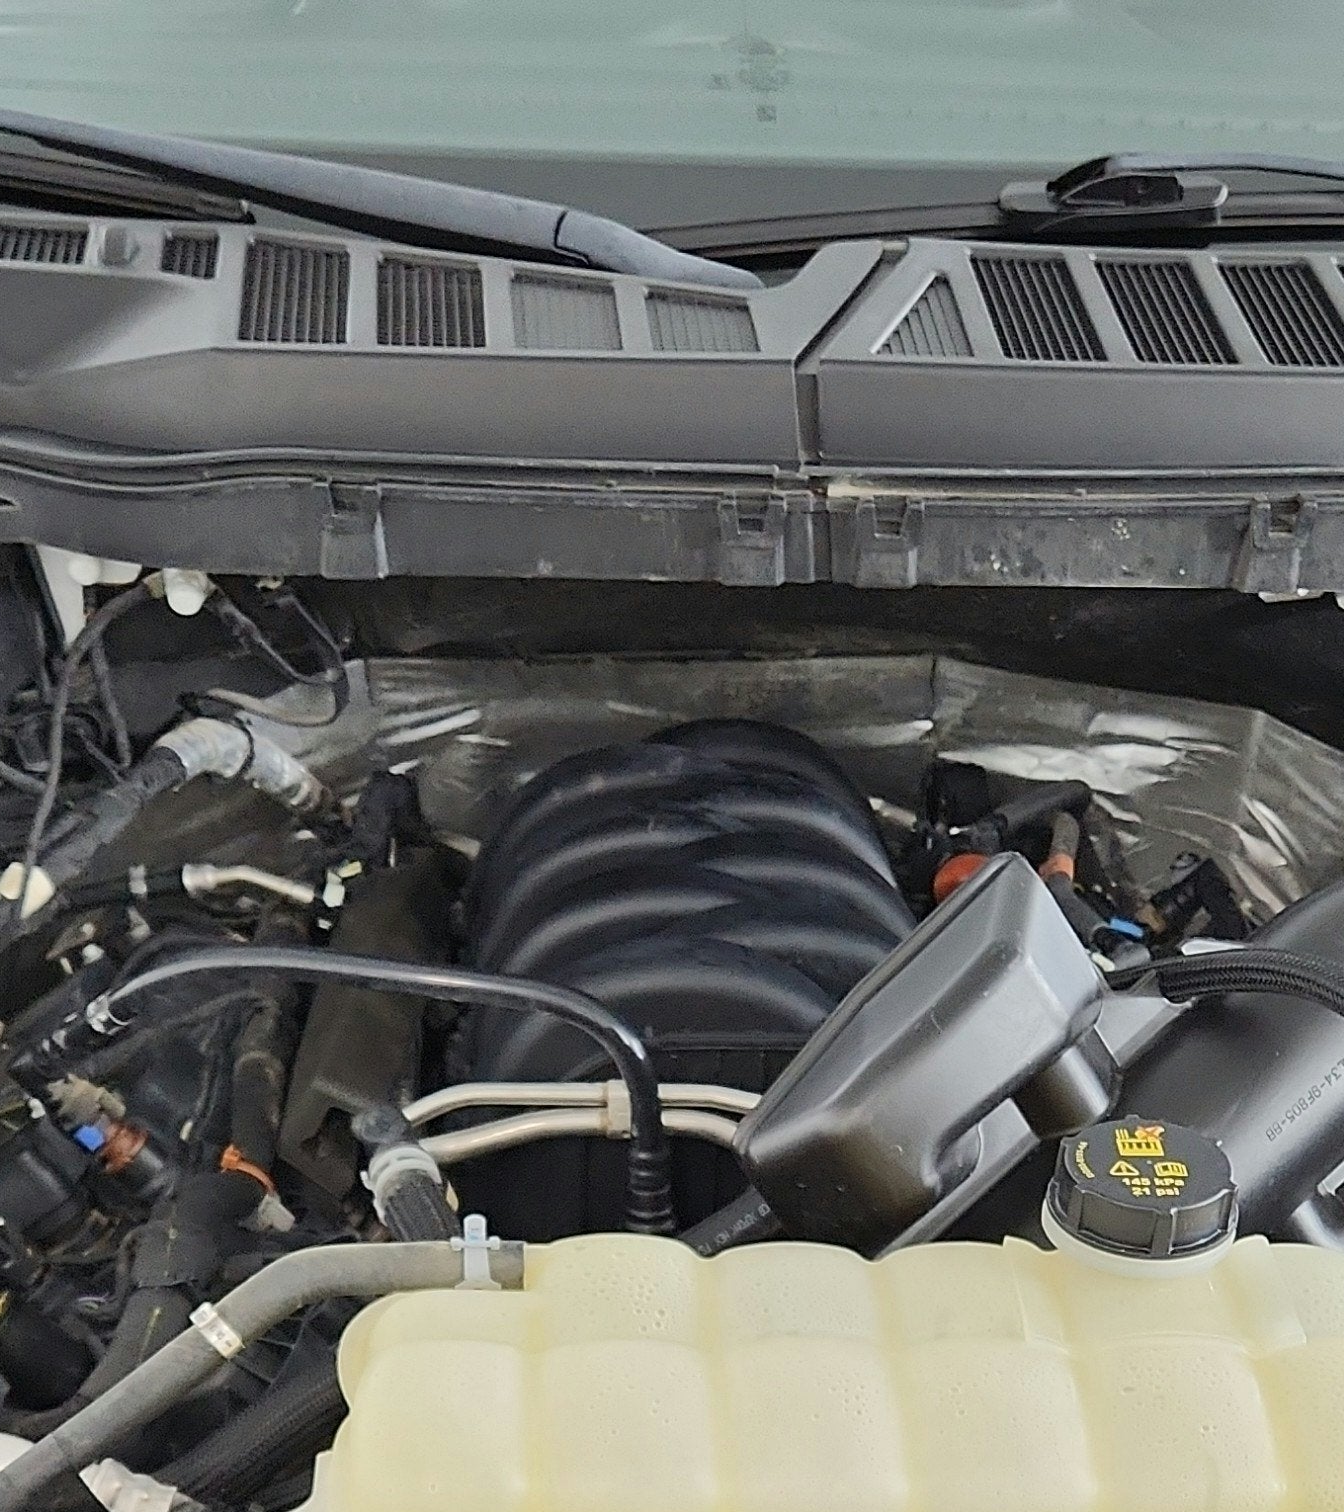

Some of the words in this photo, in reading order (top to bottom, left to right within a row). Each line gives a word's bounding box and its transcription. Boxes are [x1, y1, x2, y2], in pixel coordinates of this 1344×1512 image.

[1122, 1177, 1151, 1186] 145
[1153, 1177, 1185, 1187] kPa
[1131, 1187, 1151, 1197] 21
[1155, 1187, 1180, 1197] psi
